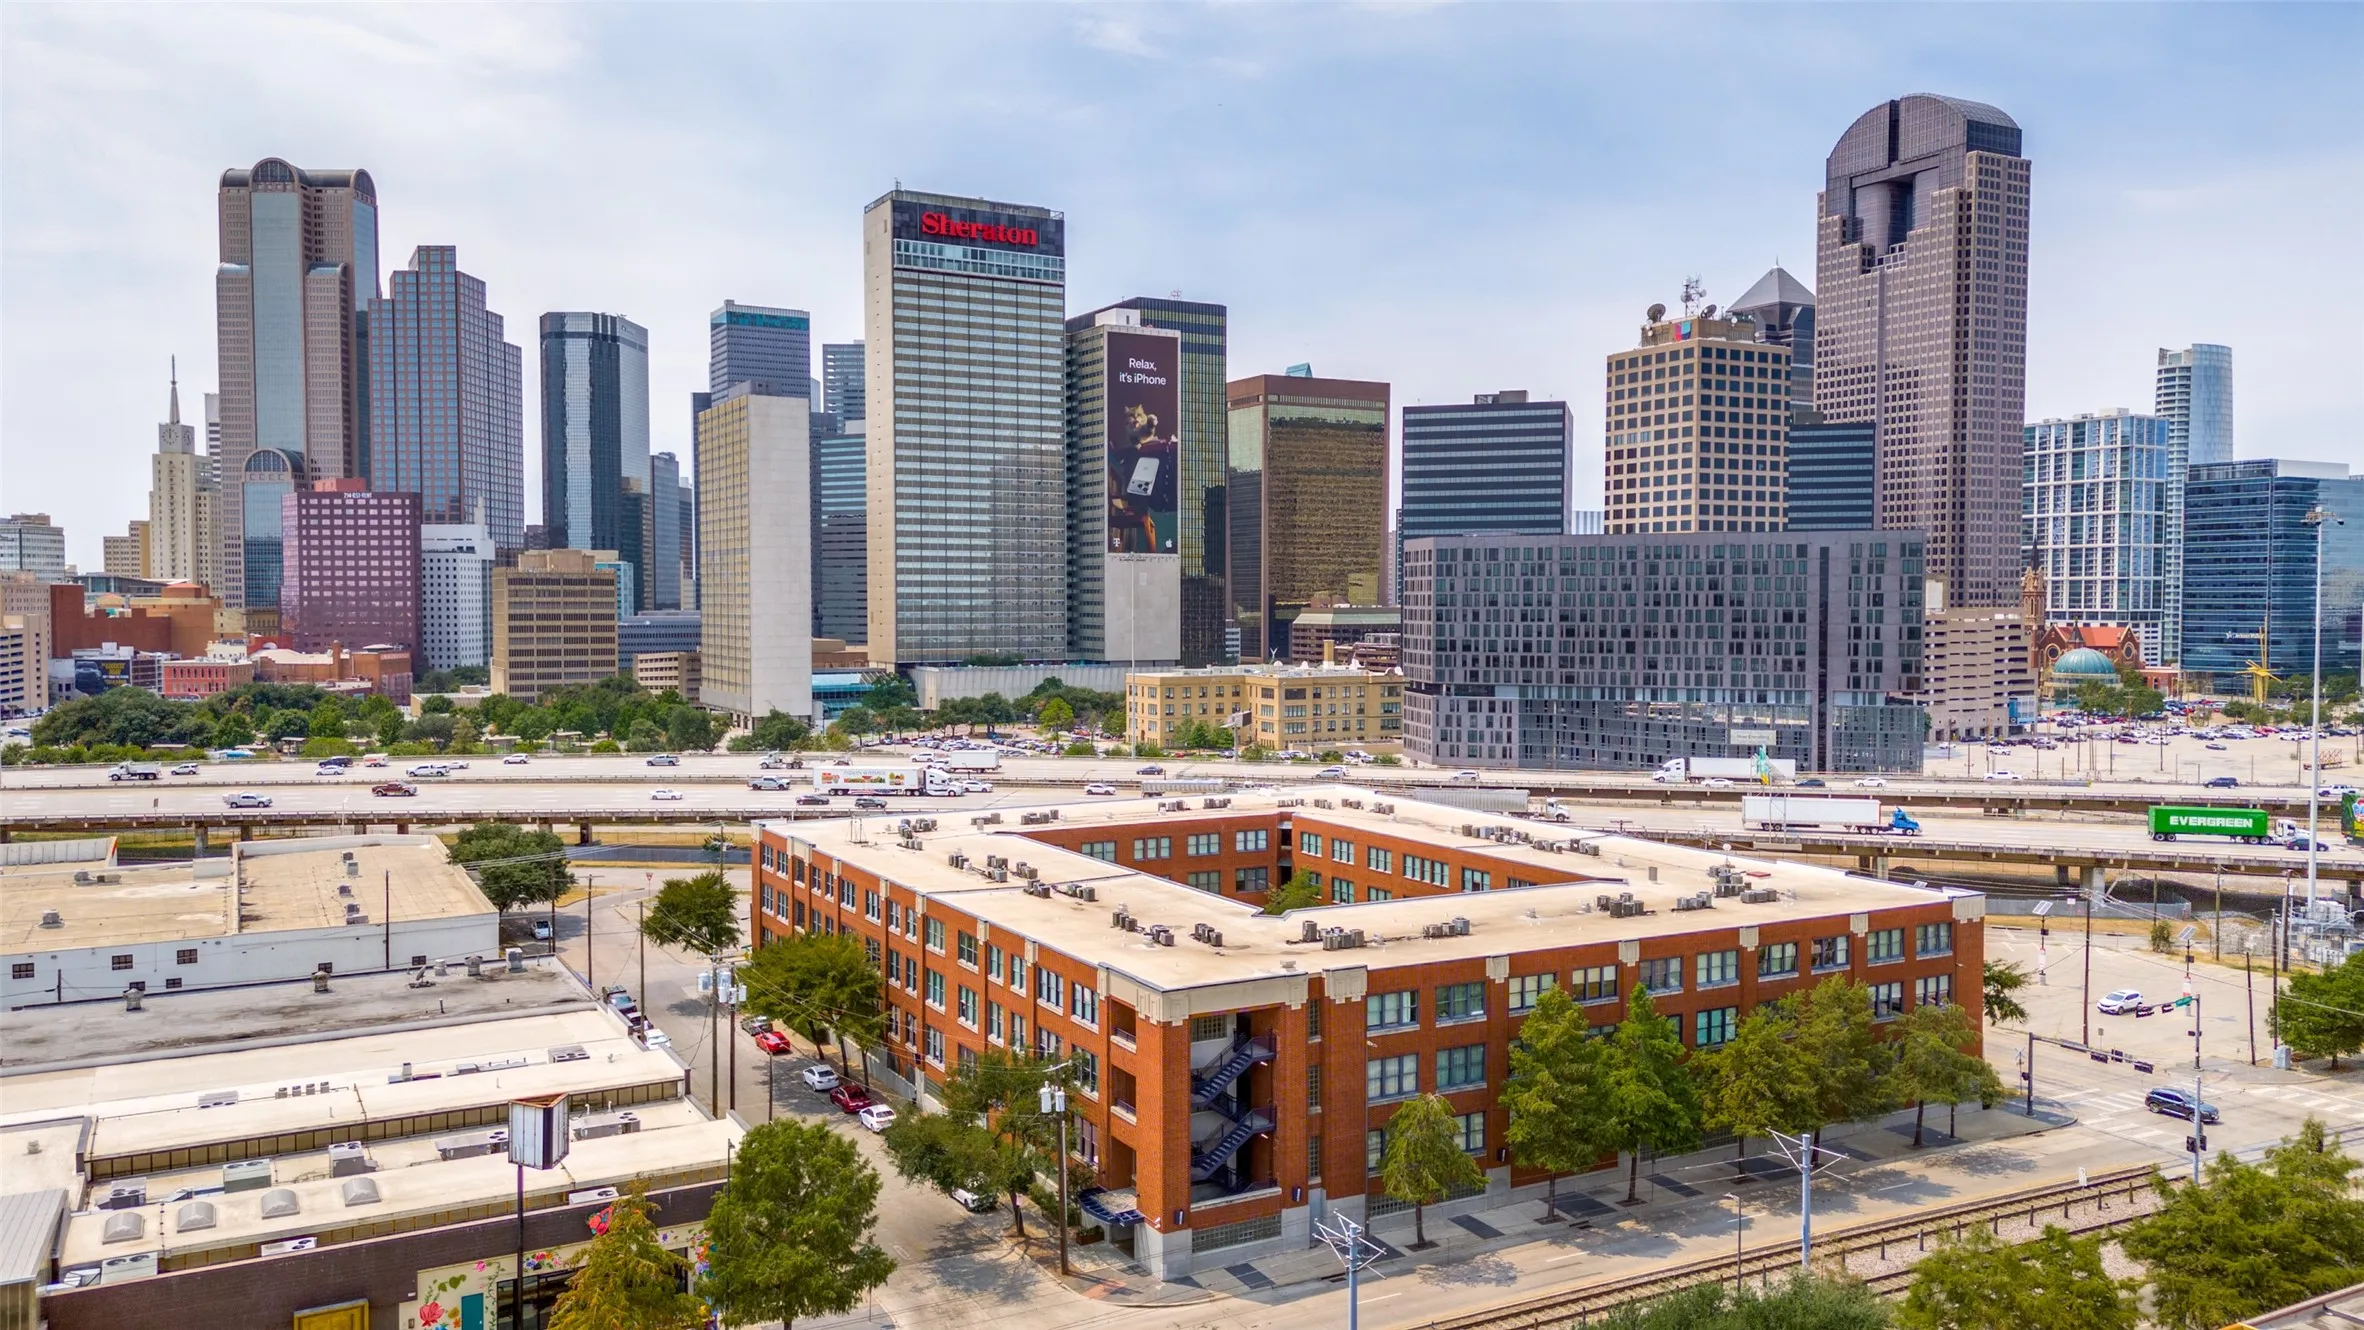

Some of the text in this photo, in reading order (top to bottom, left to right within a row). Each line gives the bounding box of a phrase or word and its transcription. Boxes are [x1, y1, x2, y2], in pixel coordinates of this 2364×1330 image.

[921, 211, 1037, 246] Sheraton
[1129, 357, 1157, 372] Relax,
[1134, 372, 1167, 386] iPhone
[2169, 815, 2253, 828] EVERGREEN
